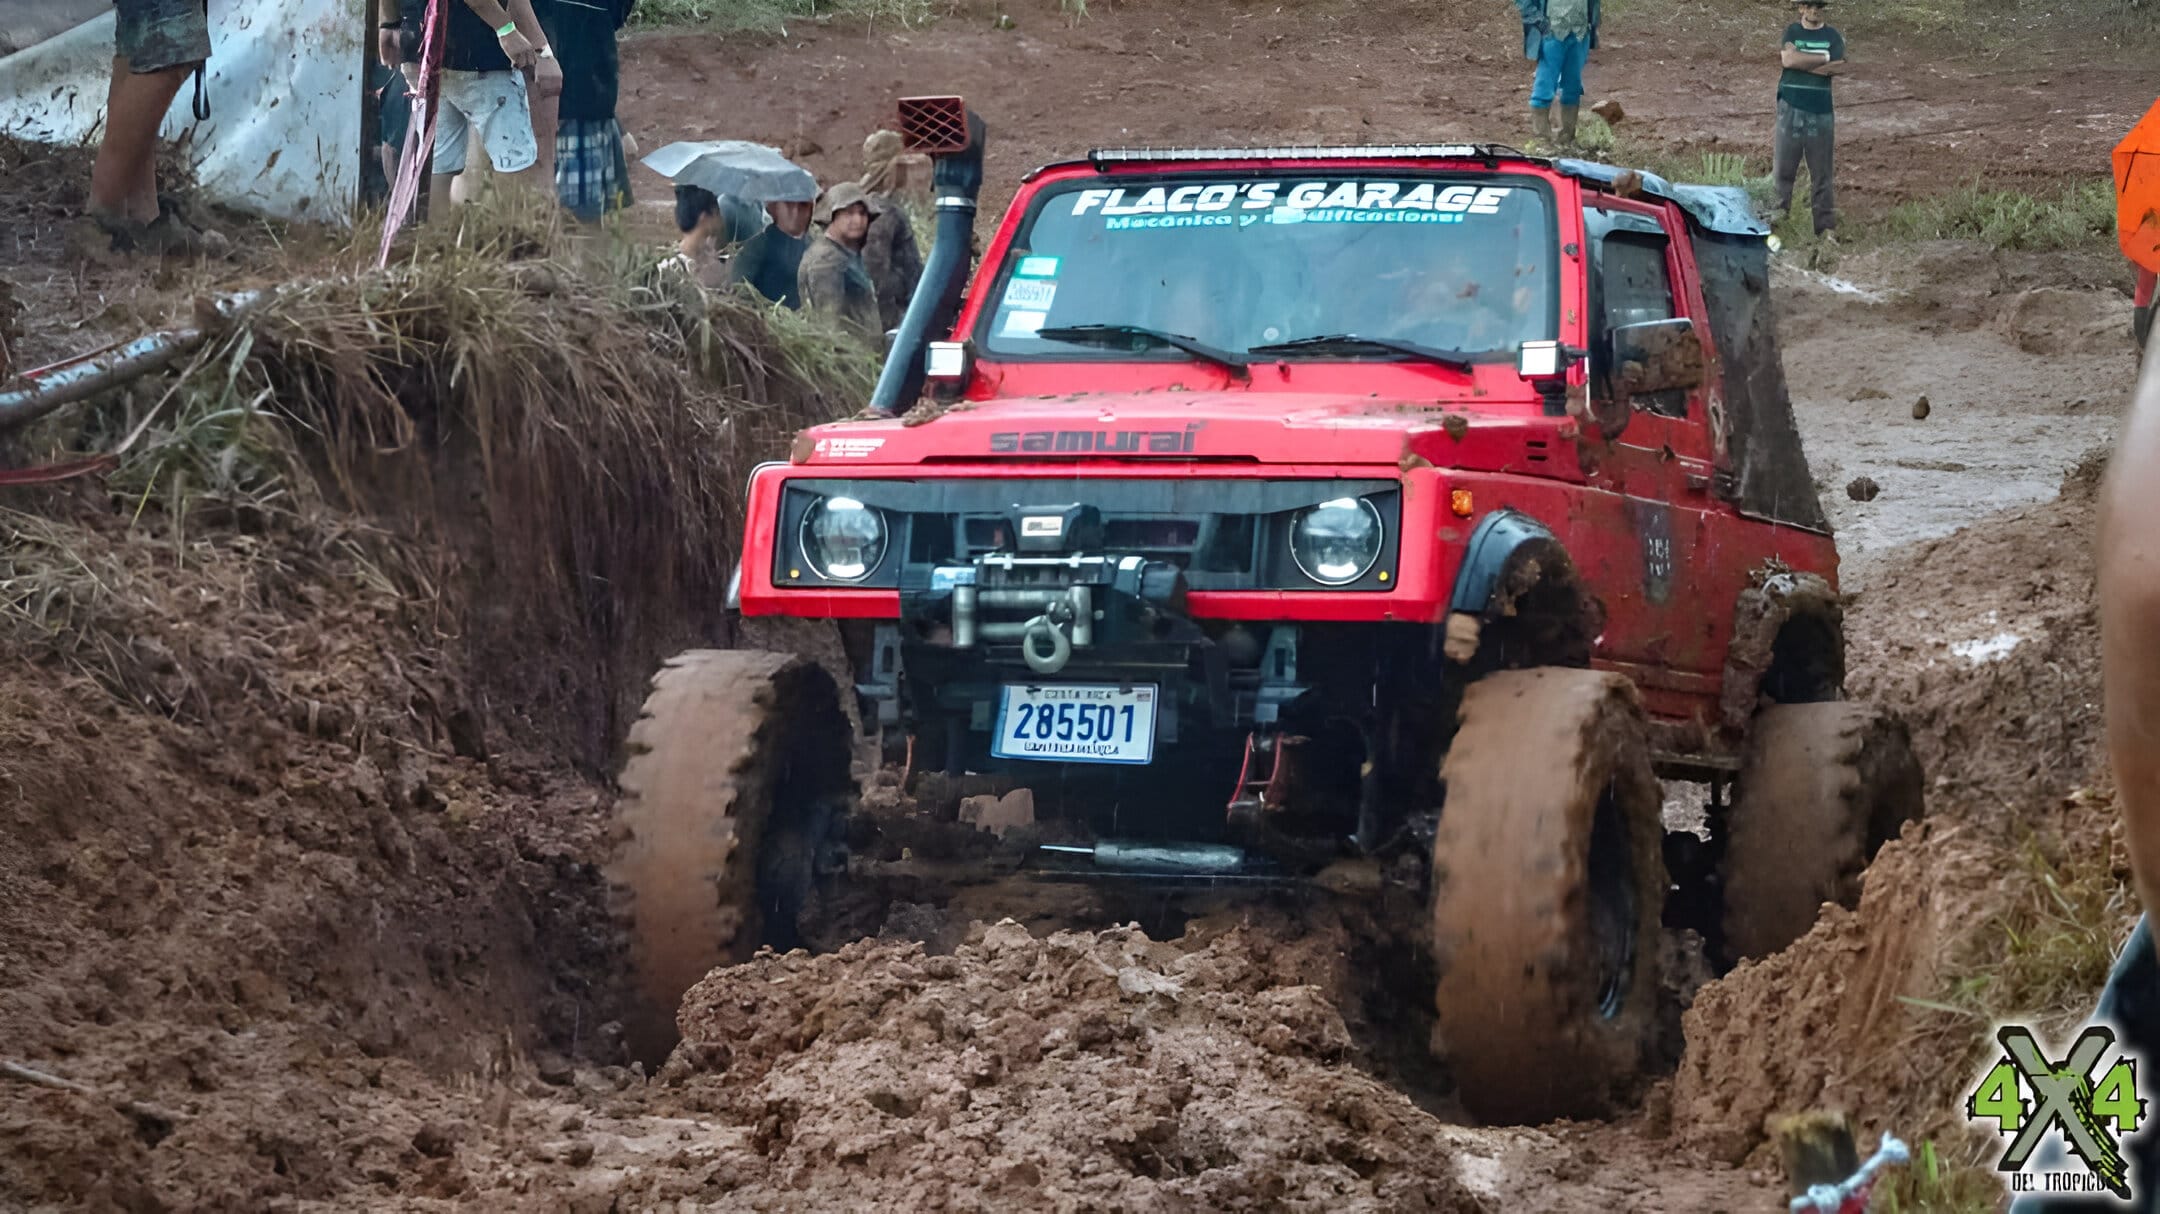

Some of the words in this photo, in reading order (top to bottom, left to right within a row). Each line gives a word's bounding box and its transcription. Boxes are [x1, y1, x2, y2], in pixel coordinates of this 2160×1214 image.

[1071, 182, 1281, 216] FLACO'S
[1286, 181, 1512, 215] GARAGE
[1013, 703, 1135, 743] 285501
